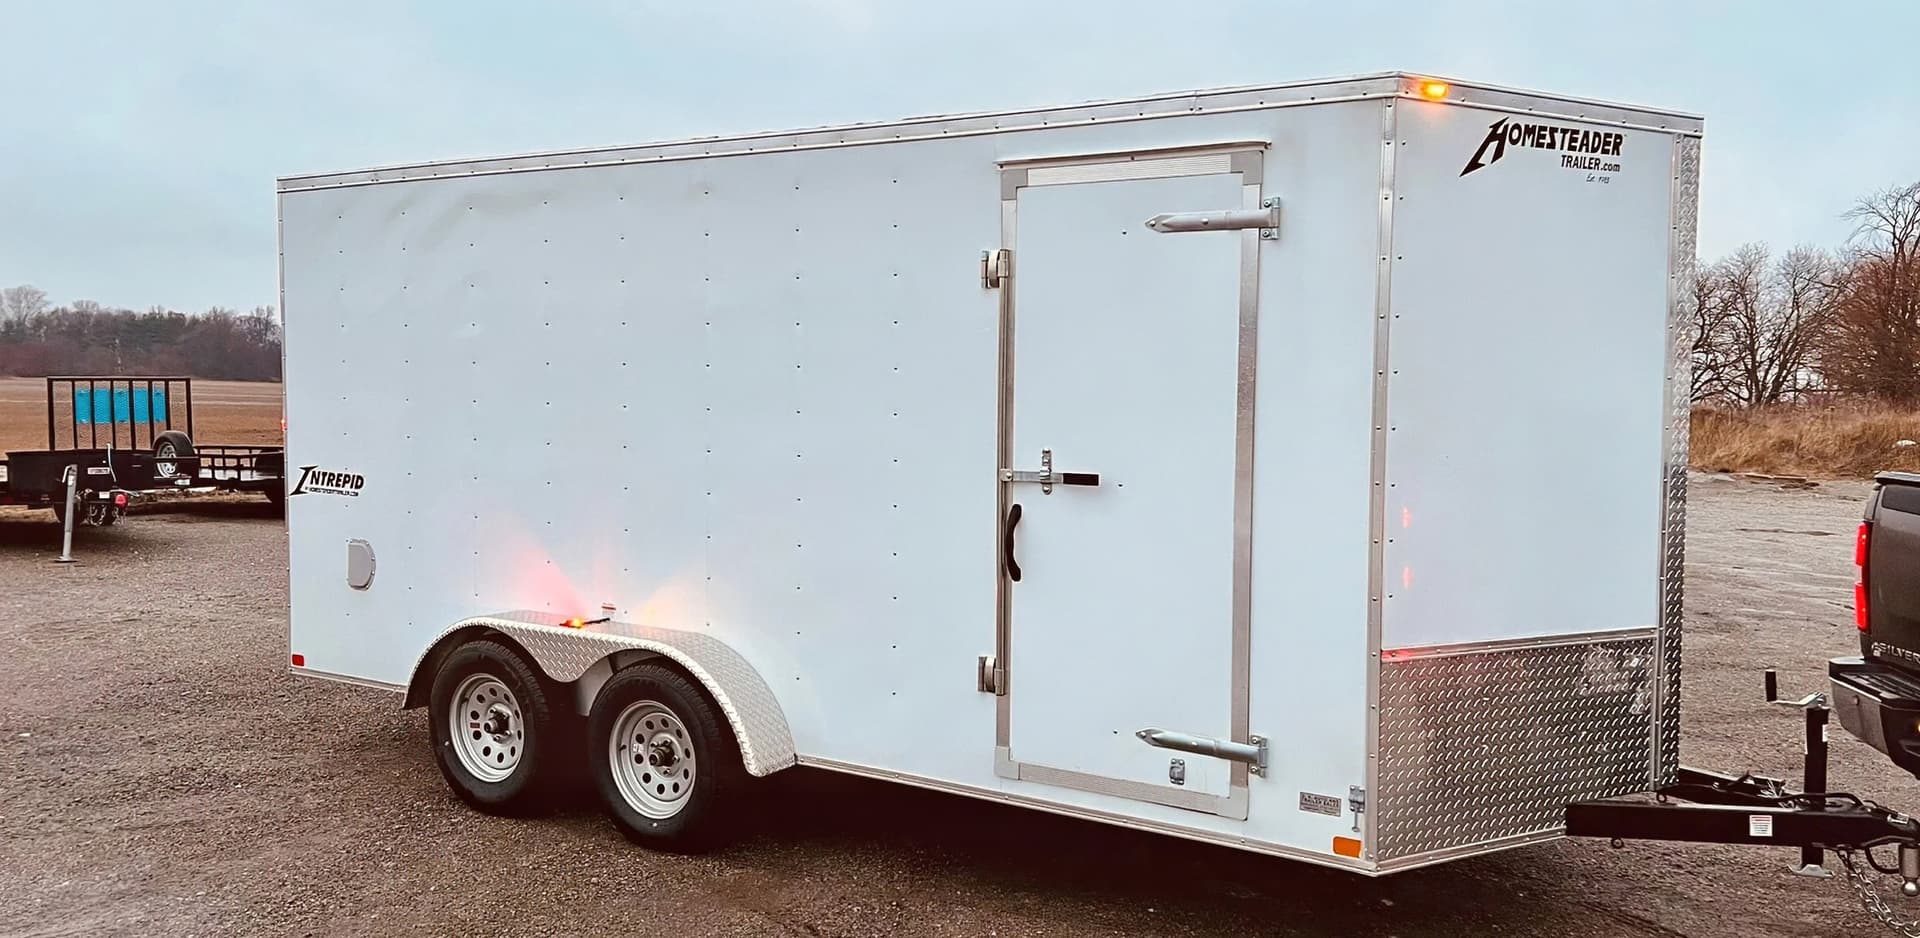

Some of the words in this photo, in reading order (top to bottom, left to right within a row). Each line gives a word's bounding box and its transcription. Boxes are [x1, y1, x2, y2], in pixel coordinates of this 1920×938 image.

[1459, 116, 1623, 177] HOMESTEADER
[1561, 154, 1620, 172] TRAILER.com
[290, 465, 364, 496] INTREPID
